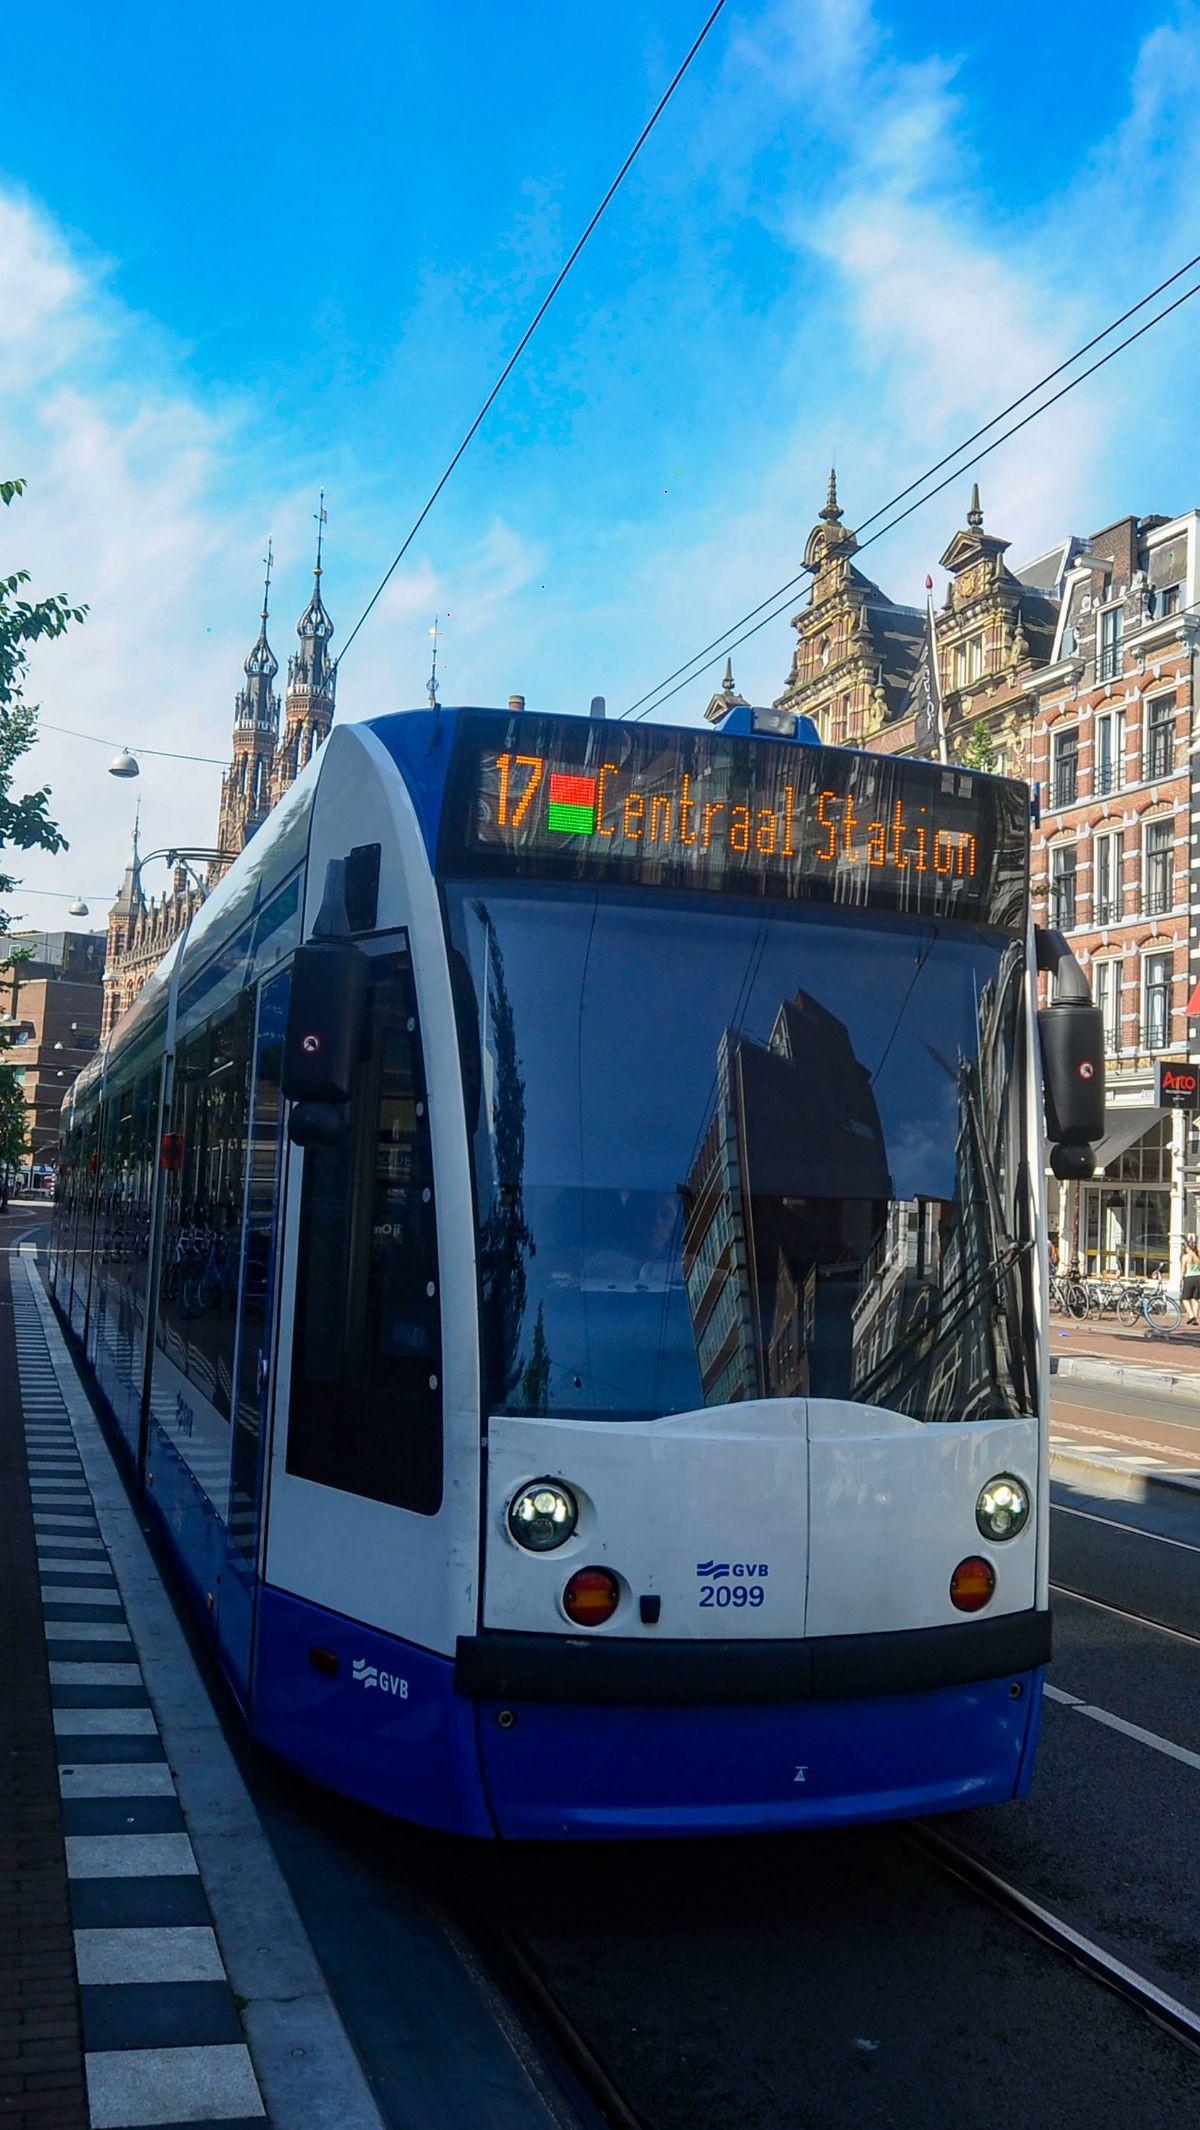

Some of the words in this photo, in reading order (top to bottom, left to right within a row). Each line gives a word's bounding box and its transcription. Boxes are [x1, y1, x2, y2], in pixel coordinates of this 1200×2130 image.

[495, 753, 543, 827] 17
[597, 762, 793, 856] Centraal
[816, 790, 977, 877] Station
[732, 1563, 769, 1577] GVB
[698, 1585, 765, 1608] 2099
[378, 1671, 409, 1700] GVB
